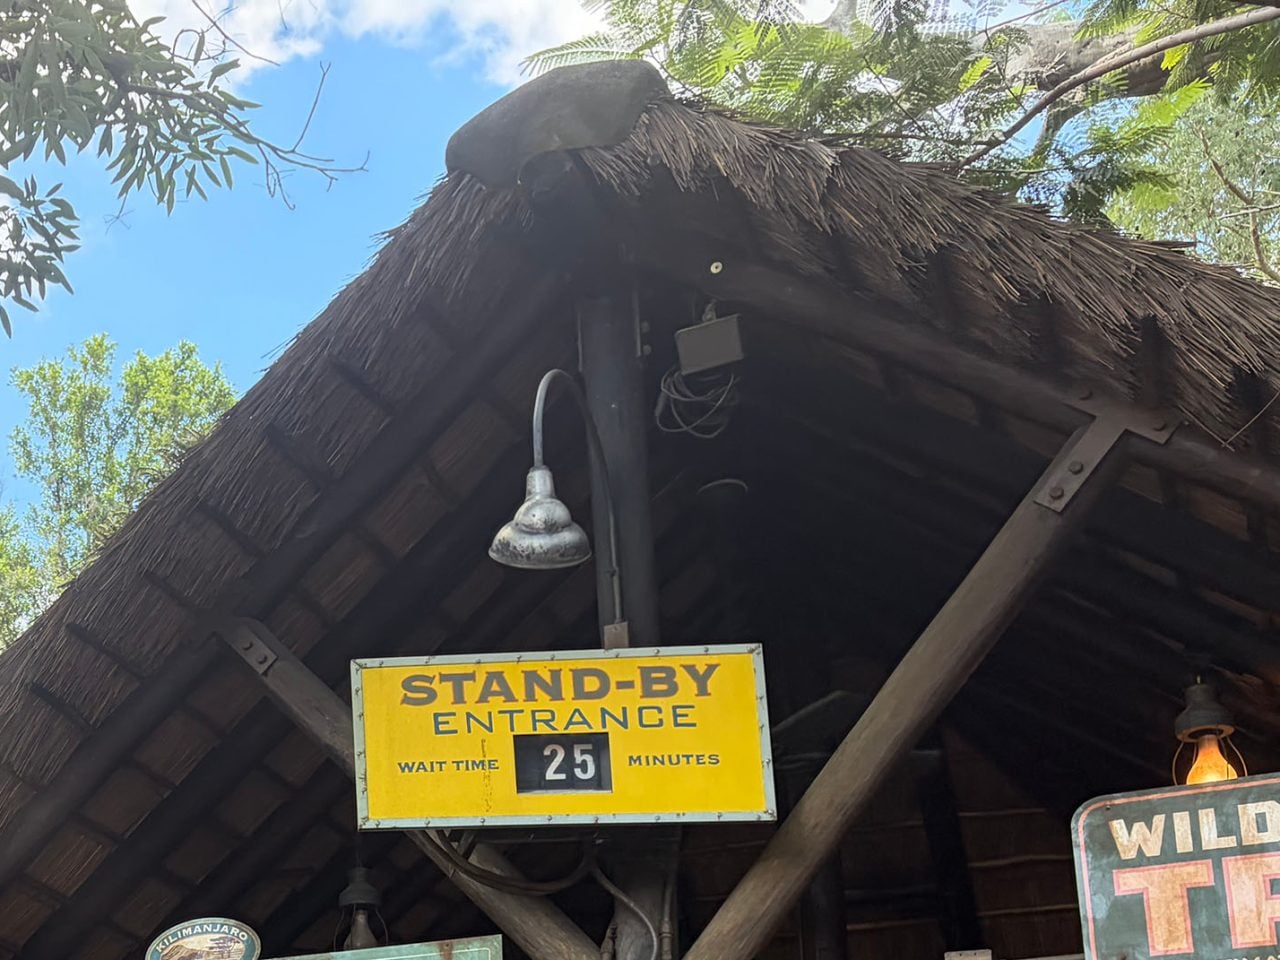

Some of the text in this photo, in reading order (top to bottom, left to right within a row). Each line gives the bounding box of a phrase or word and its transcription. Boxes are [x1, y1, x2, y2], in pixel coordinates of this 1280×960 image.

[400, 663, 720, 706] STAND-BY
[432, 704, 697, 736] ENTRANCE
[397, 743, 720, 781] WAIT TIME 25 MINUTES
[1109, 800, 1280, 860] WILD
[156, 924, 248, 952] KILIMANJARO
